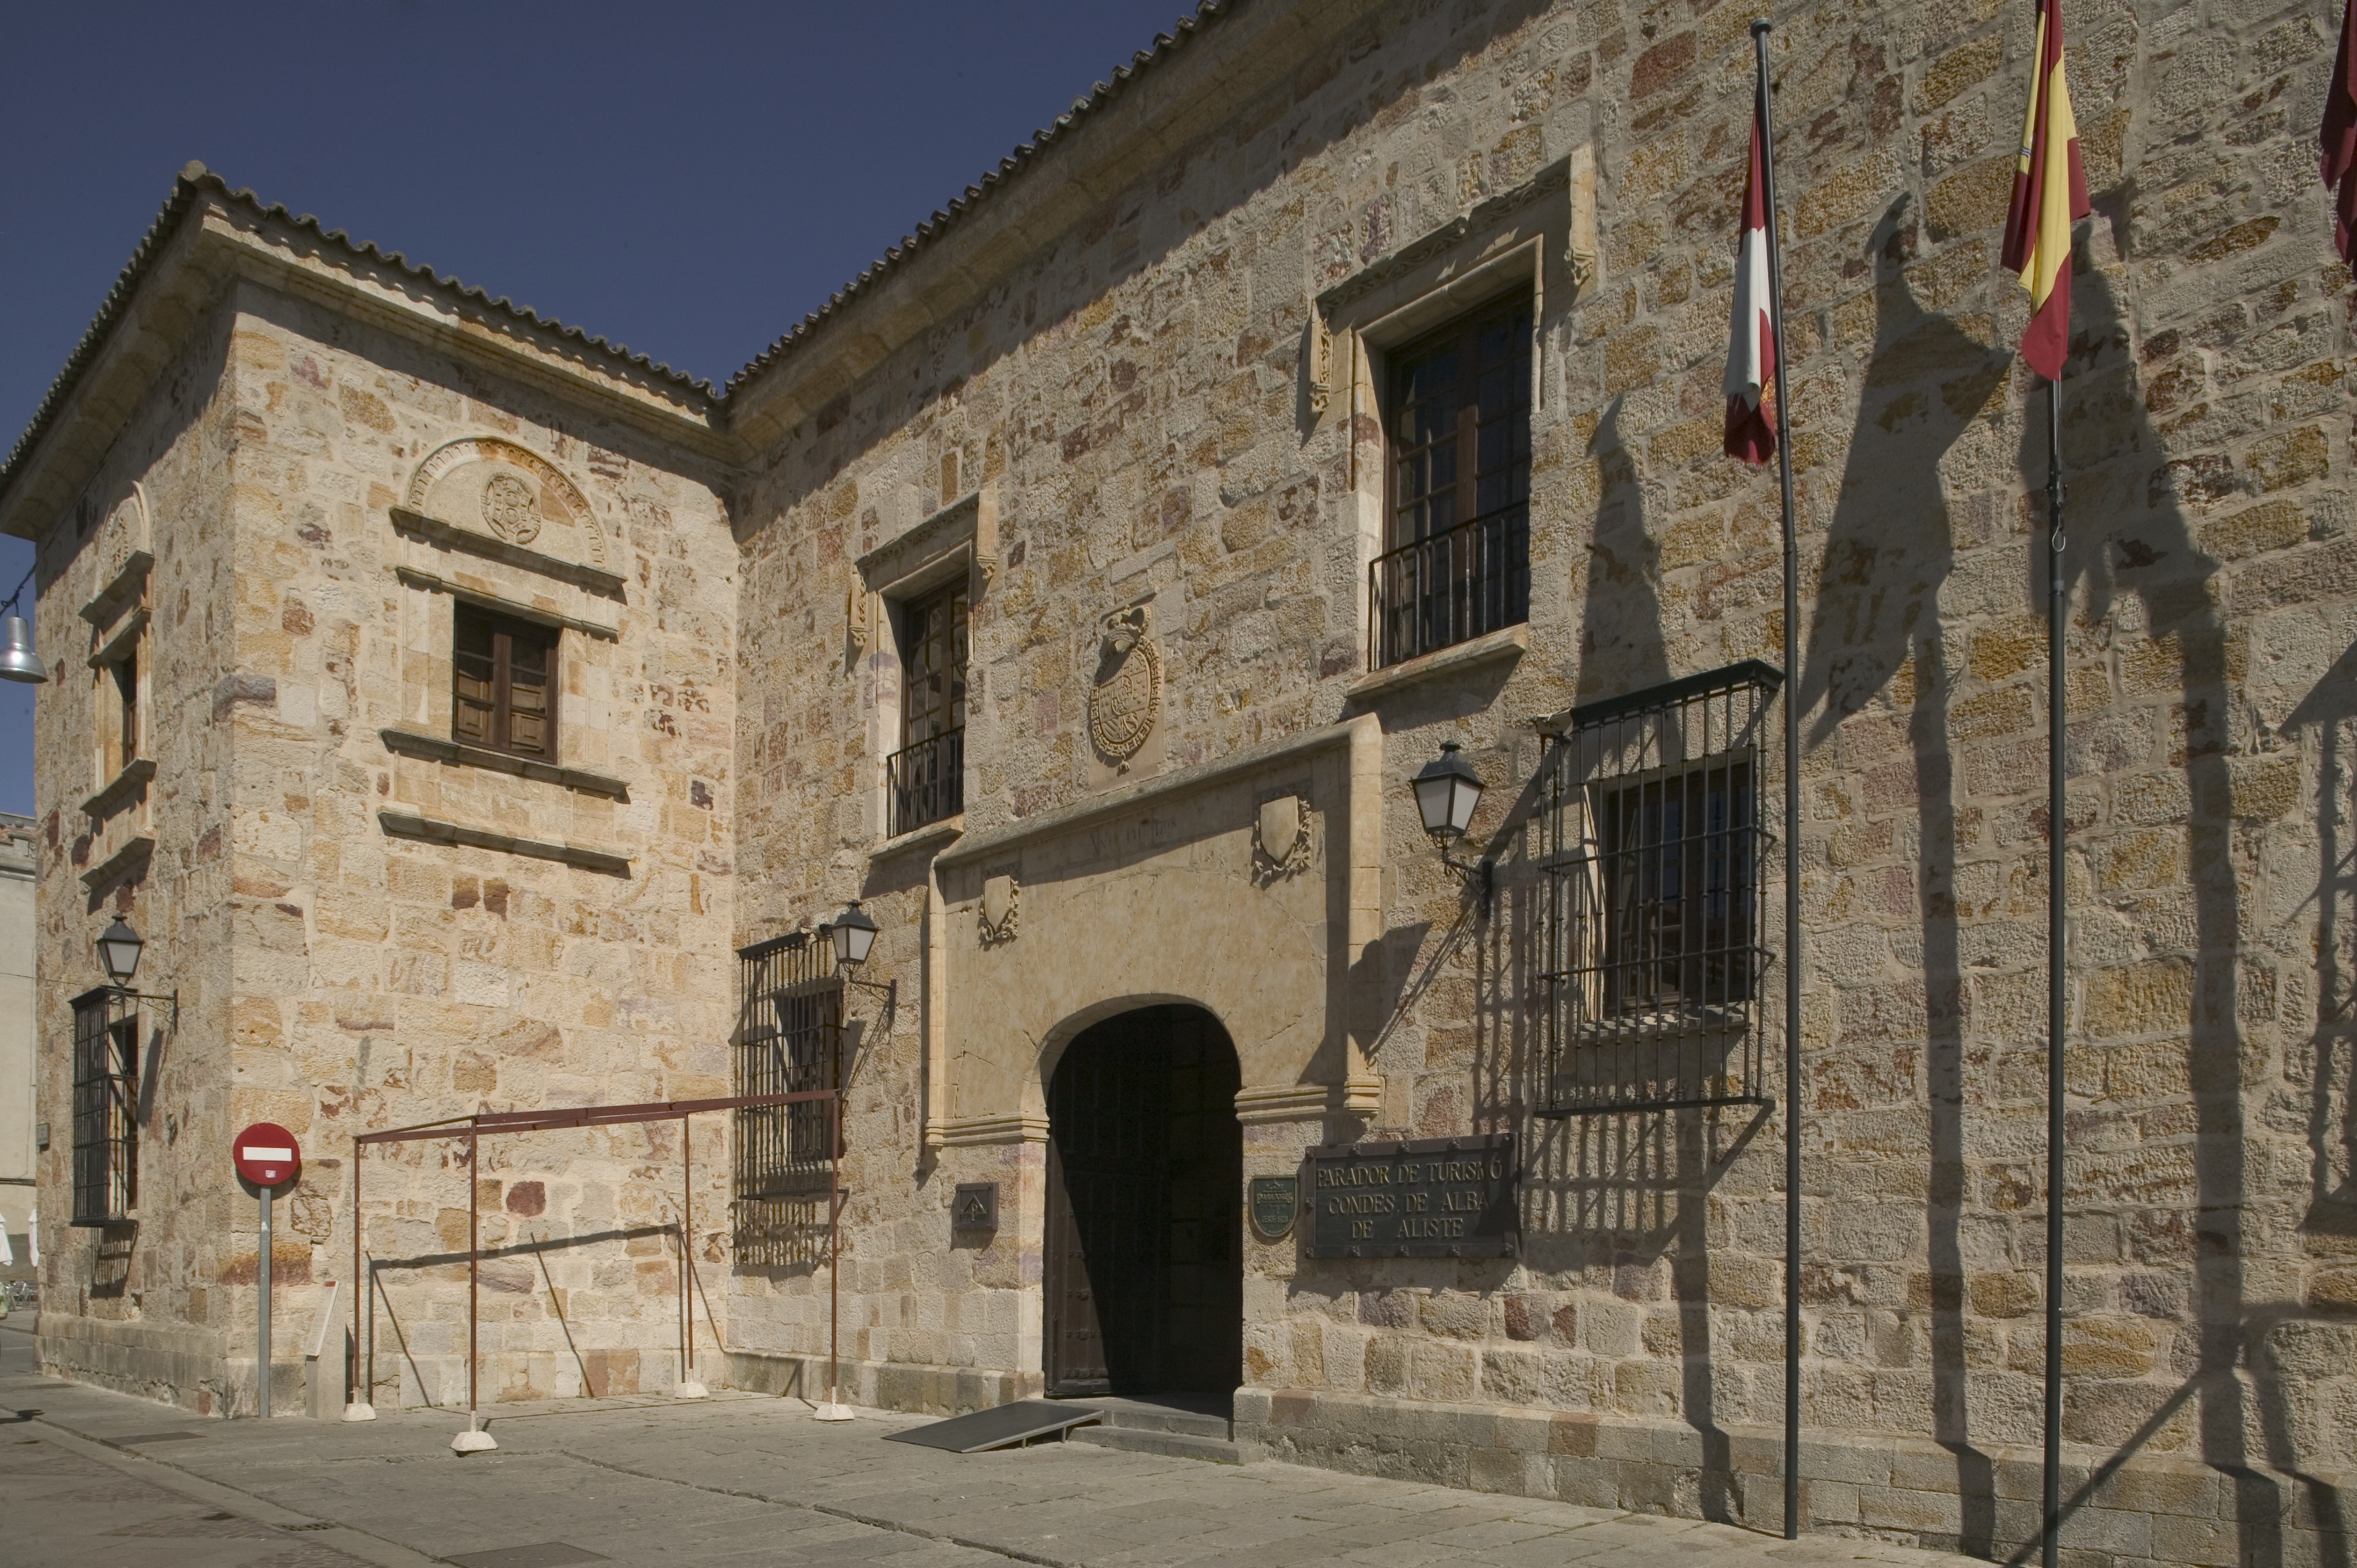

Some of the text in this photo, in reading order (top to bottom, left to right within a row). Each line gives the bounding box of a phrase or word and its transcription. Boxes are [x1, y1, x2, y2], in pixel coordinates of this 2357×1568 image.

[1317, 1160, 1502, 1187] PARADOR DE TURISMO
[1329, 1191, 1489, 1214] CONDES DE ALBA
[1352, 1218, 1464, 1239] DE ALISTE
